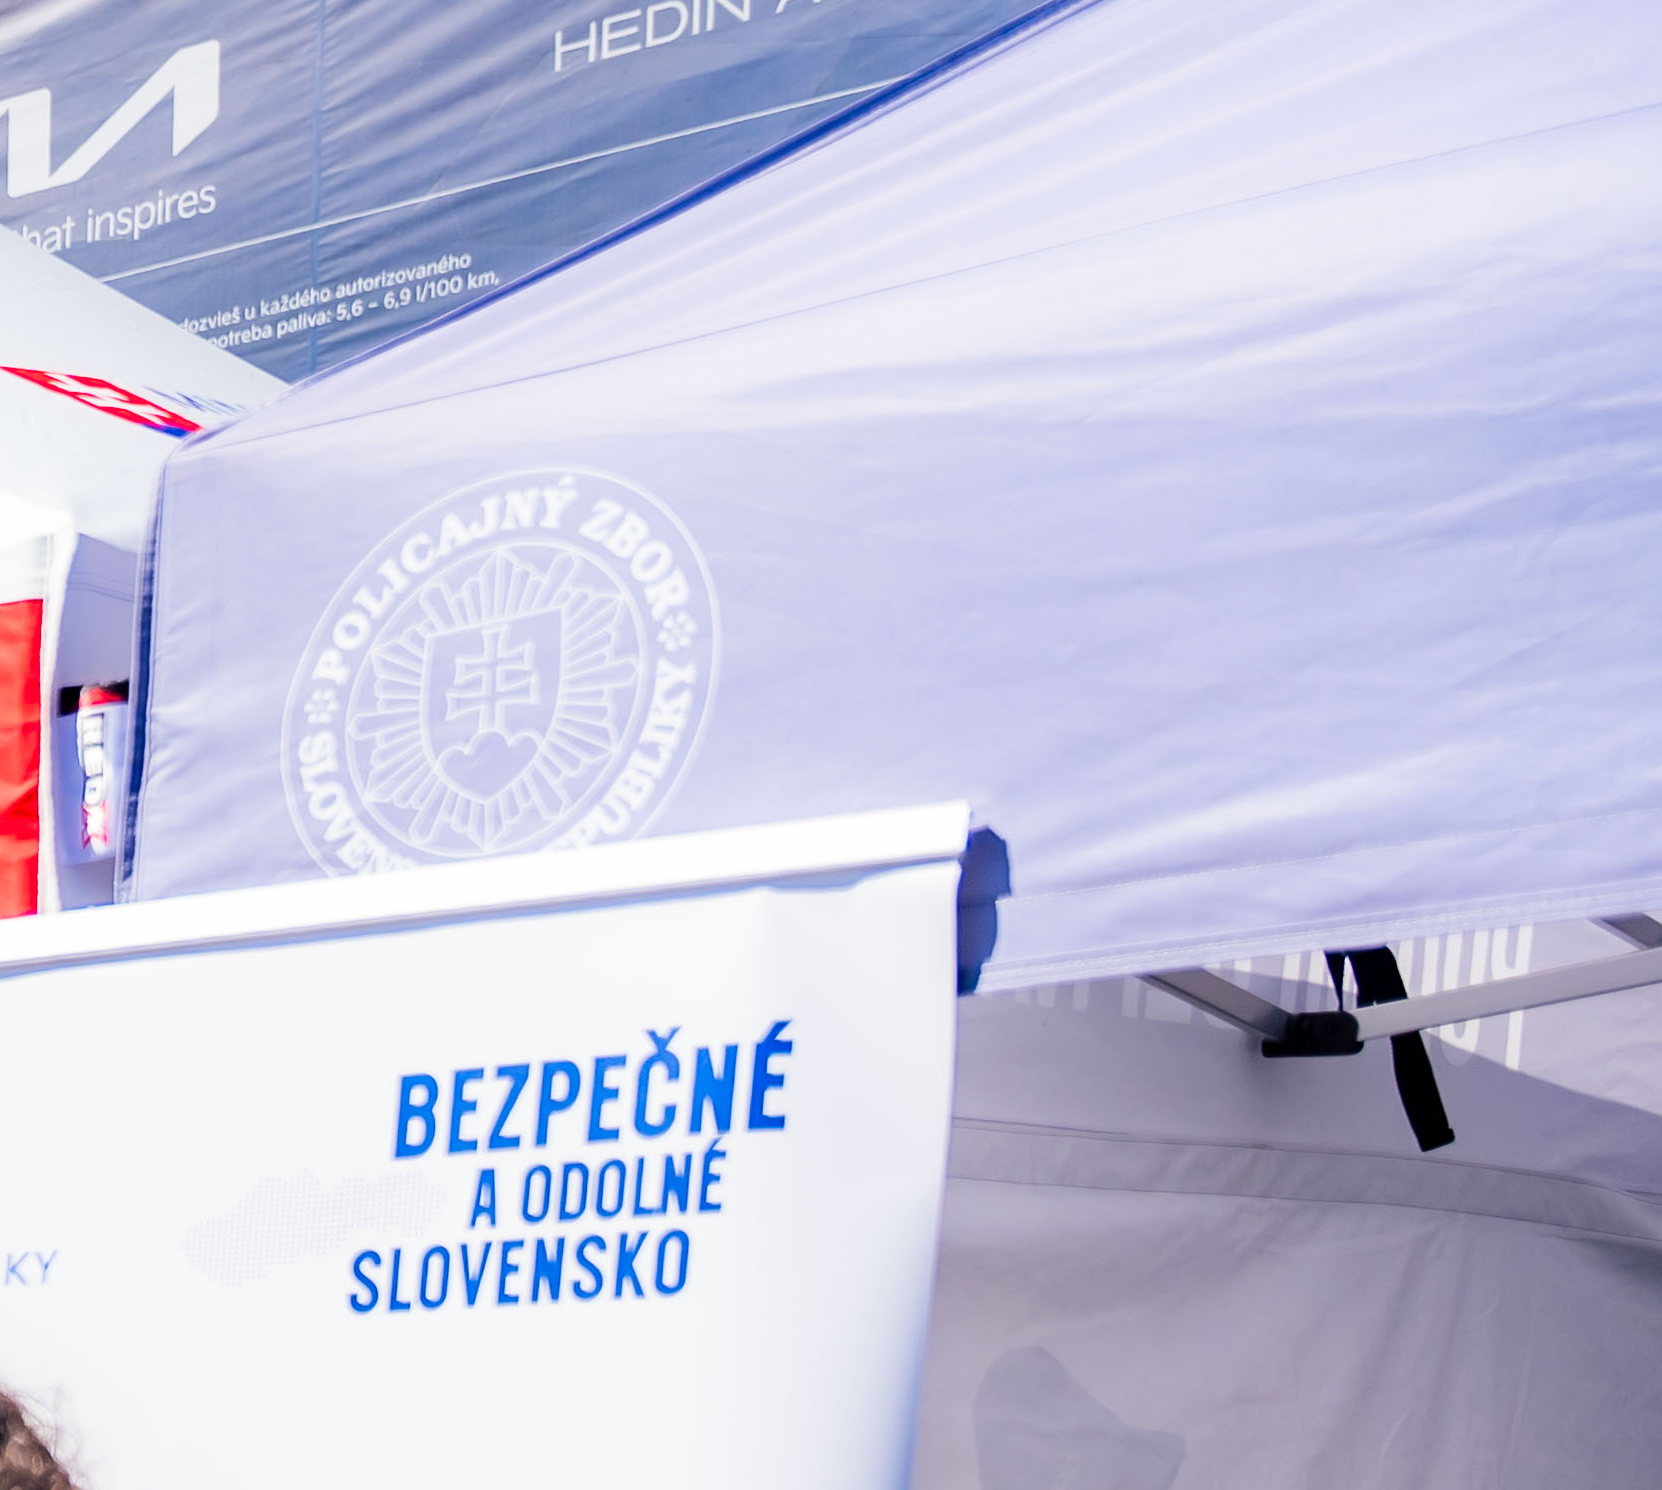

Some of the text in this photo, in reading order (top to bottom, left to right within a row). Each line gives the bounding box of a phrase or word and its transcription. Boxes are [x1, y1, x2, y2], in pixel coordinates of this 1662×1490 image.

[17, 184, 217, 255] hat inspires
[244, 305, 256, 321] u
[260, 287, 331, 318] každého
[335, 252, 473, 301] autorizovaného
[277, 310, 333, 339] paliva:
[335, 297, 364, 322] 5,6
[383, 288, 412, 311] 6,9
[466, 269, 500, 292] km,
[315, 474, 691, 686] POLICAJNÝ ZBOR
[554, 656, 697, 852] PUBLIKY
[393, 1019, 795, 1160] BEZPEČNÉ
[470, 1138, 729, 1228] A ODOLNÉ
[349, 1228, 691, 1313] SLOVENSKO
